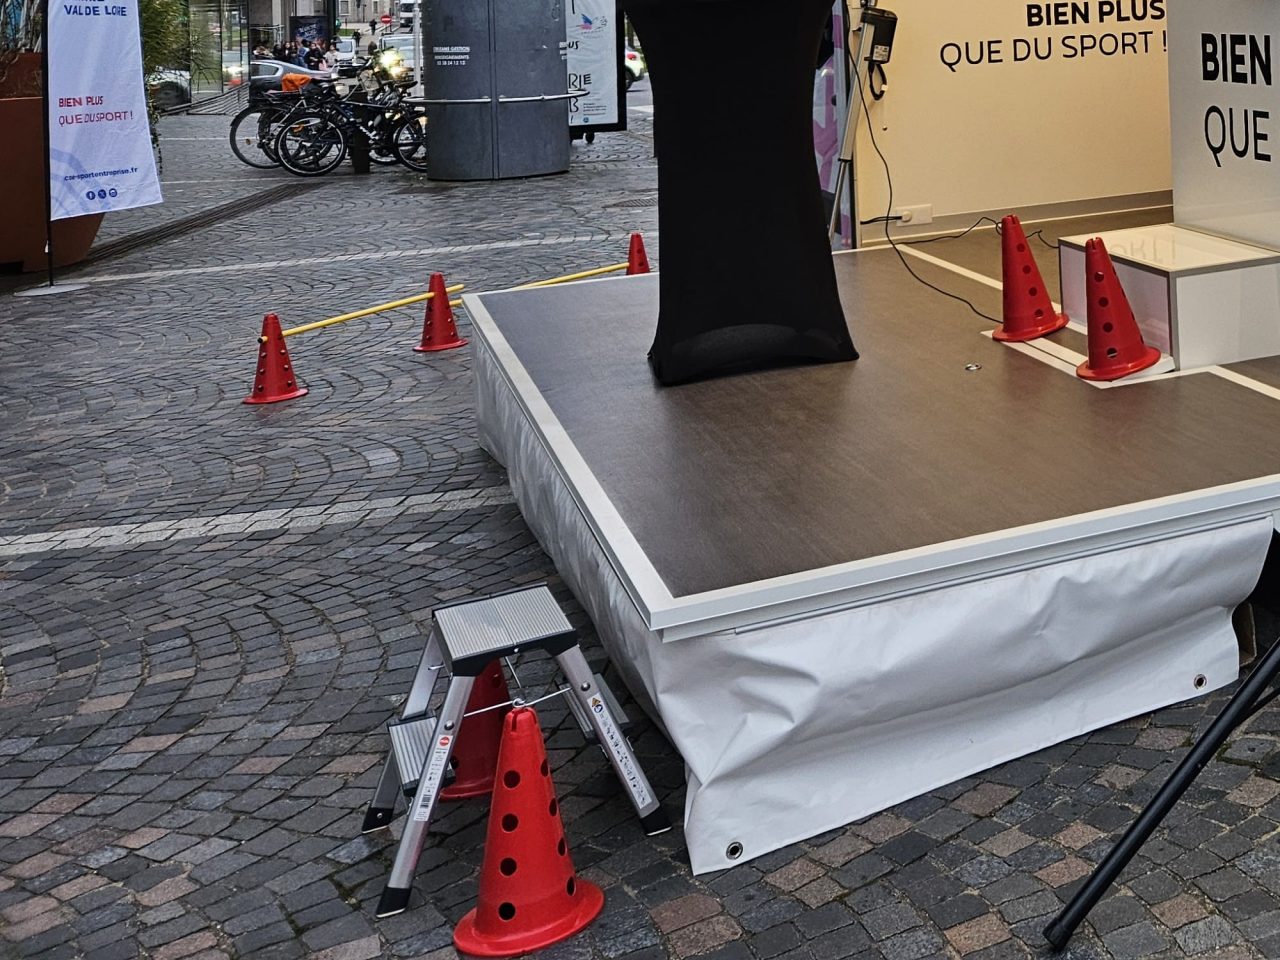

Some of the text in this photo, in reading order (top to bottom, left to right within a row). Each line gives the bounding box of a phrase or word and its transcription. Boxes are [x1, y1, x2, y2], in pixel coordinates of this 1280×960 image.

[64, 5, 84, 15] VAL
[85, 6, 100, 16] DE
[1026, 2, 1090, 27] BIEN
[940, 40, 1003, 72] QUE
[1013, 37, 1051, 62] DU
[1061, 31, 1154, 58] SPORT
[1201, 33, 1272, 86] BIEN
[59, 96, 103, 107] BIEN PLUS
[58, 114, 83, 127] QUE
[84, 113, 95, 123] DU
[96, 111, 128, 122] SPORT
[1204, 105, 1271, 168] QUE
